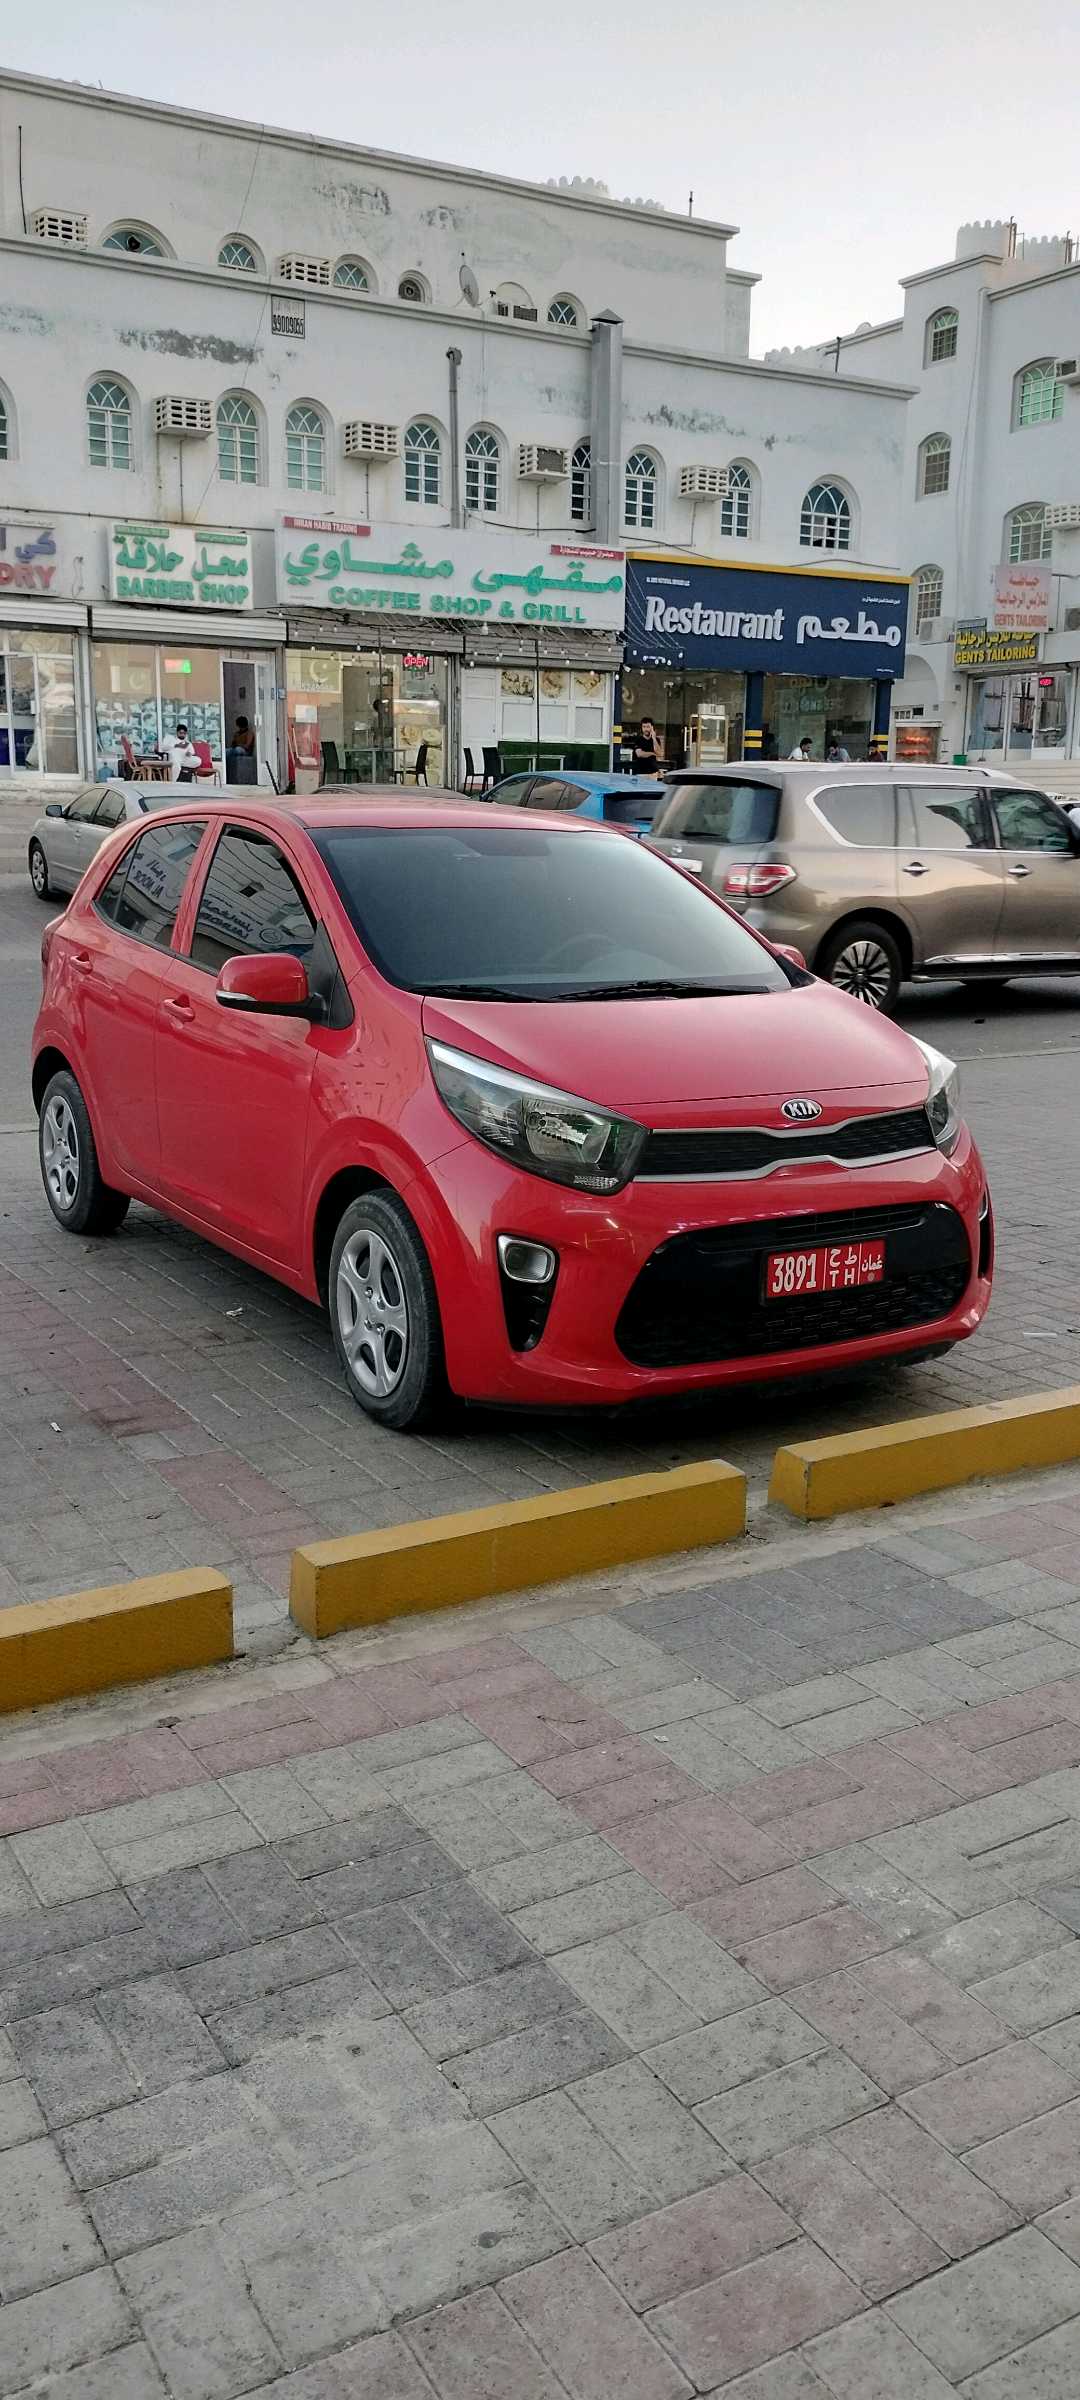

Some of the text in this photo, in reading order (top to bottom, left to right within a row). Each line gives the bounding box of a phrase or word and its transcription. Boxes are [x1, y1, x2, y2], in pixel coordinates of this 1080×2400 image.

[113, 535, 248, 581] محل حلاقة
[284, 538, 623, 597] مقهى مشاوي
[116, 576, 249, 604] BARBER SHOP
[328, 585, 587, 624] COFFEE SHOP & GRILL
[645, 595, 785, 641] Restaurant
[796, 611, 902, 647] مطعم
[403, 656, 428, 667] OPEN
[955, 644, 1036, 665] GENTS TAILORING
[787, 1101, 819, 1116] KIA
[772, 1253, 817, 1293] 3891
